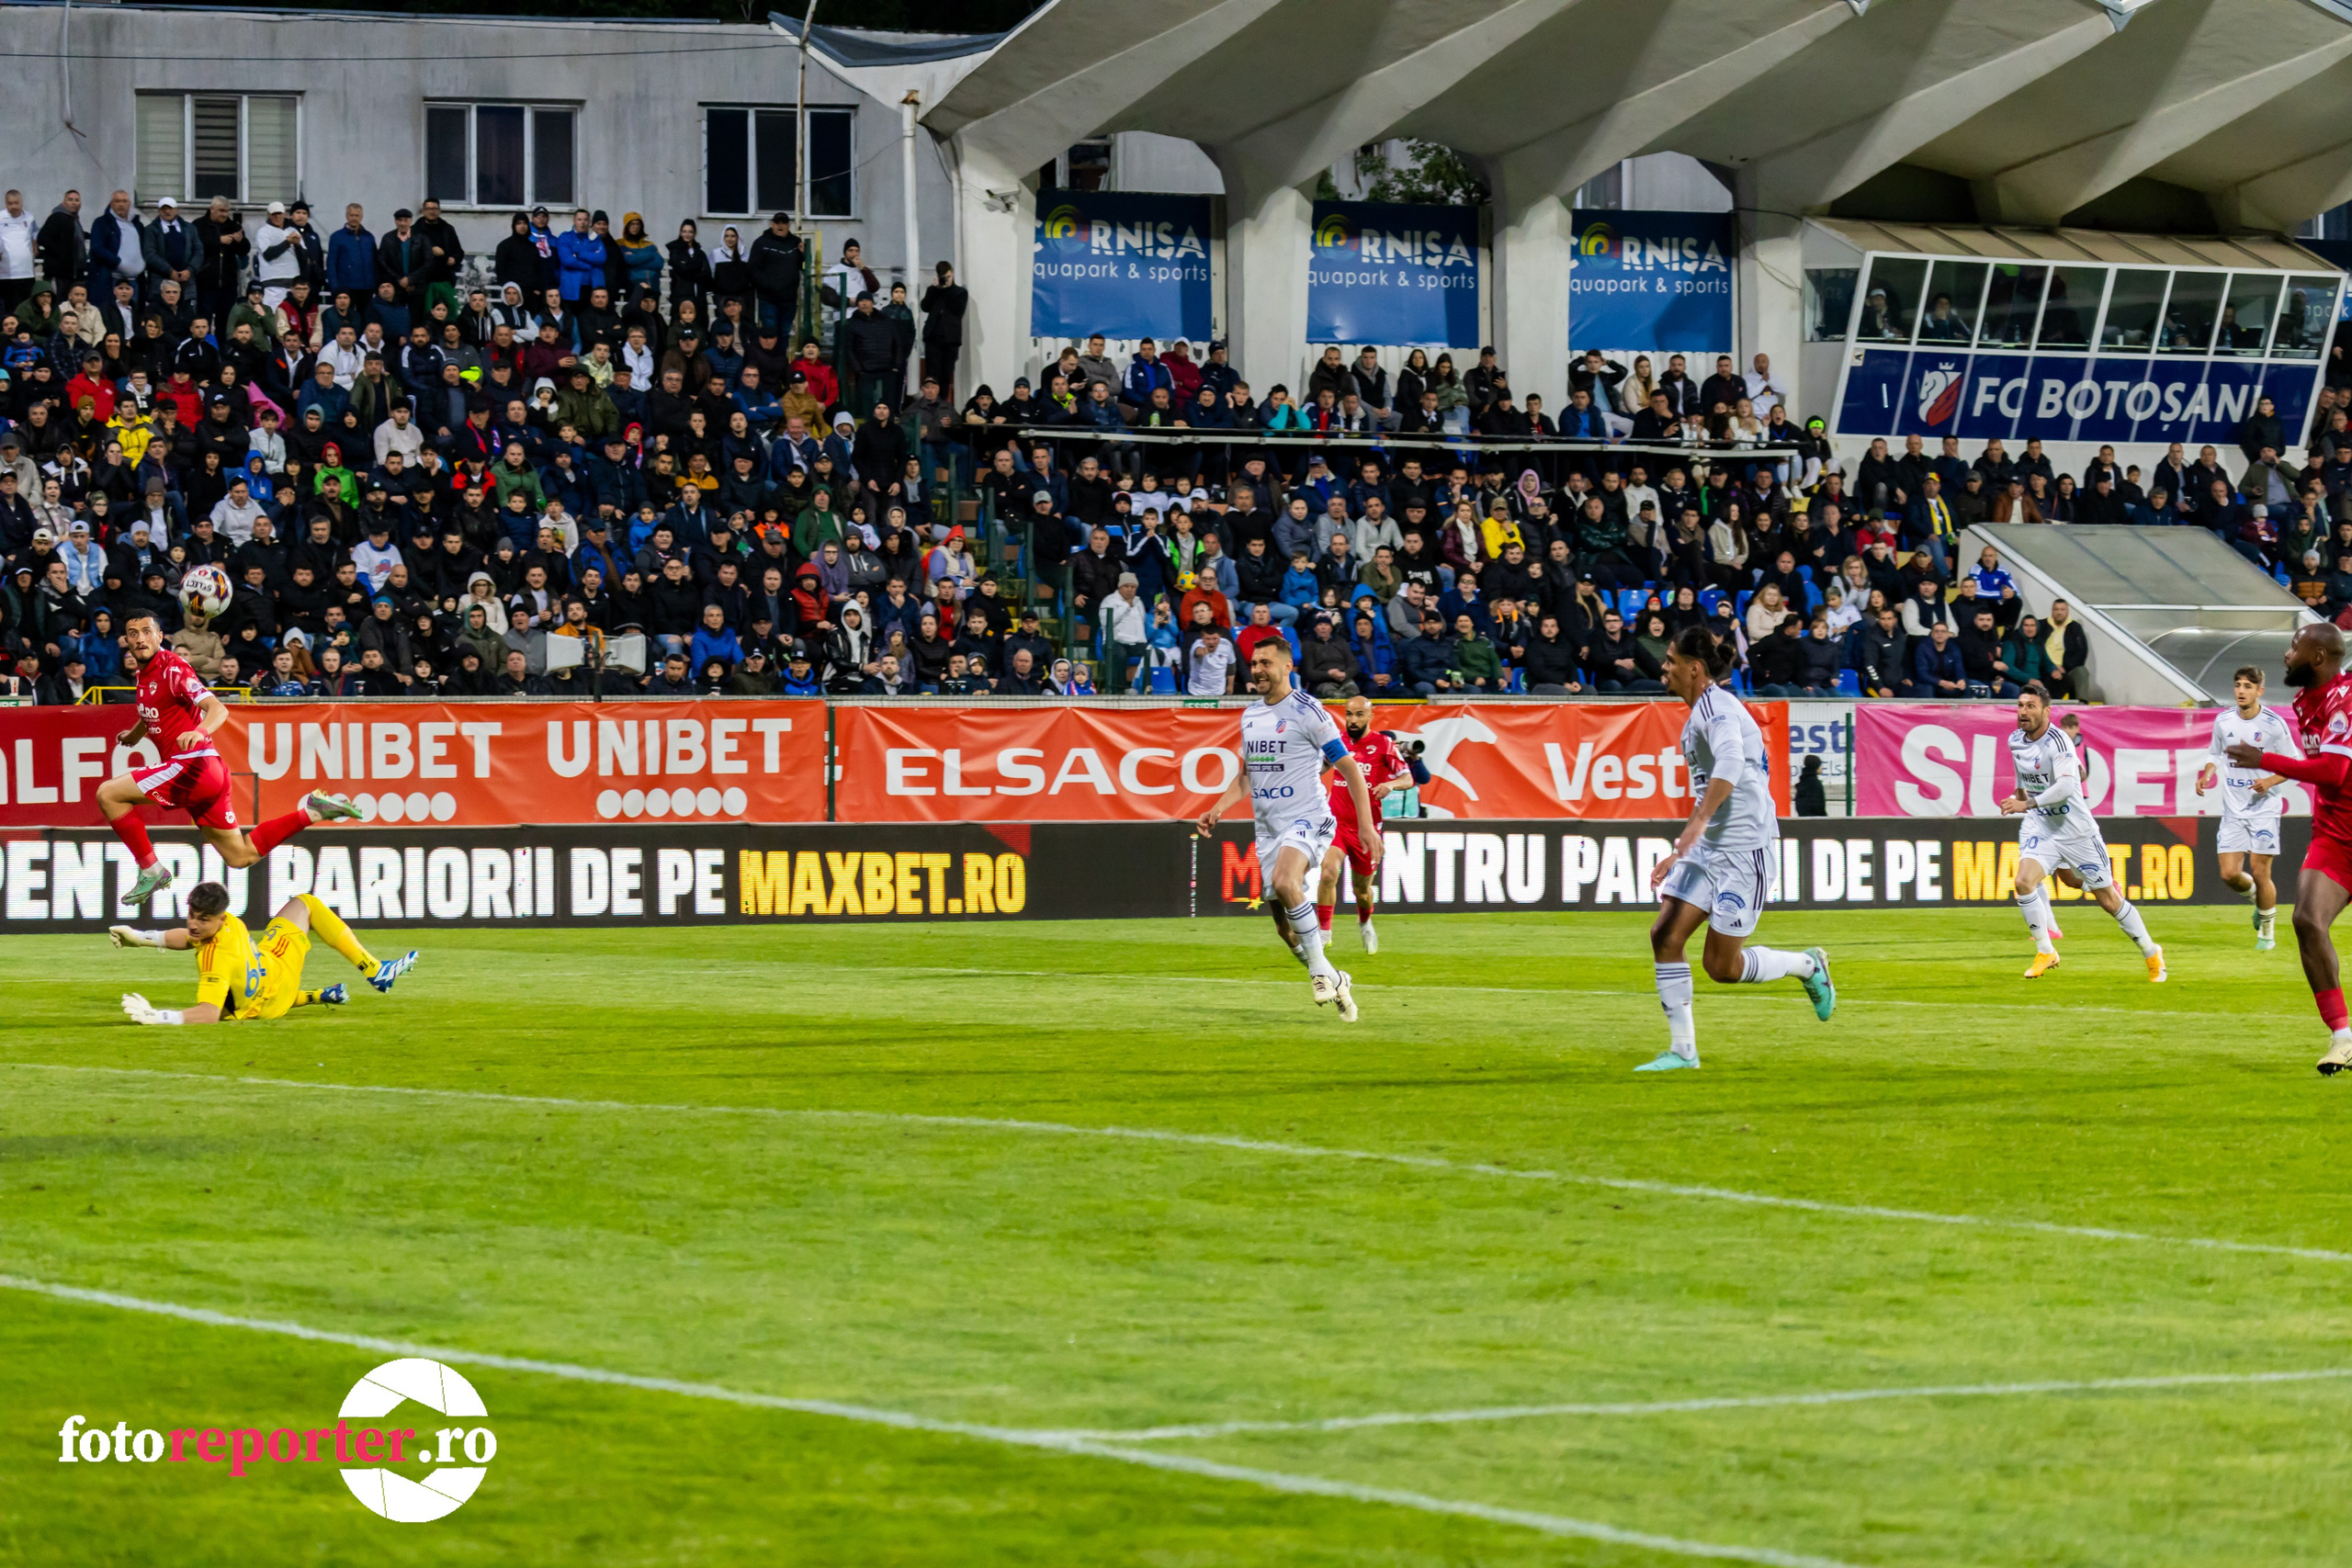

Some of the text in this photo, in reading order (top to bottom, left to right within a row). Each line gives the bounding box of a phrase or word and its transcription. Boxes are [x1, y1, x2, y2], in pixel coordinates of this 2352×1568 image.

[1128, 263, 1140, 278] &
[1149, 265, 1207, 283] sports
[1397, 271, 1409, 287] &
[1418, 272, 1476, 290] sports
[1656, 277, 1667, 293] &
[1675, 277, 1728, 296] sports
[1973, 378, 2029, 419] FC
[248, 722, 502, 780] UNIBET
[548, 718, 792, 777] UNIBET
[1247, 740, 1287, 753] NIBET
[0, 737, 162, 805] LFA
[885, 747, 1240, 796] ELSACO
[1544, 741, 1696, 801] Vest
[2022, 773, 2050, 784] NIBET
[2226, 777, 2256, 788] ELSA
[1251, 785, 1294, 799] SACO
[2037, 805, 2070, 817] SACO
[0, 840, 1025, 919] ENTRU PARIORII DE PE MAXBET.RO
[1812, 838, 1874, 902] DE
[1884, 839, 1943, 901] PE
